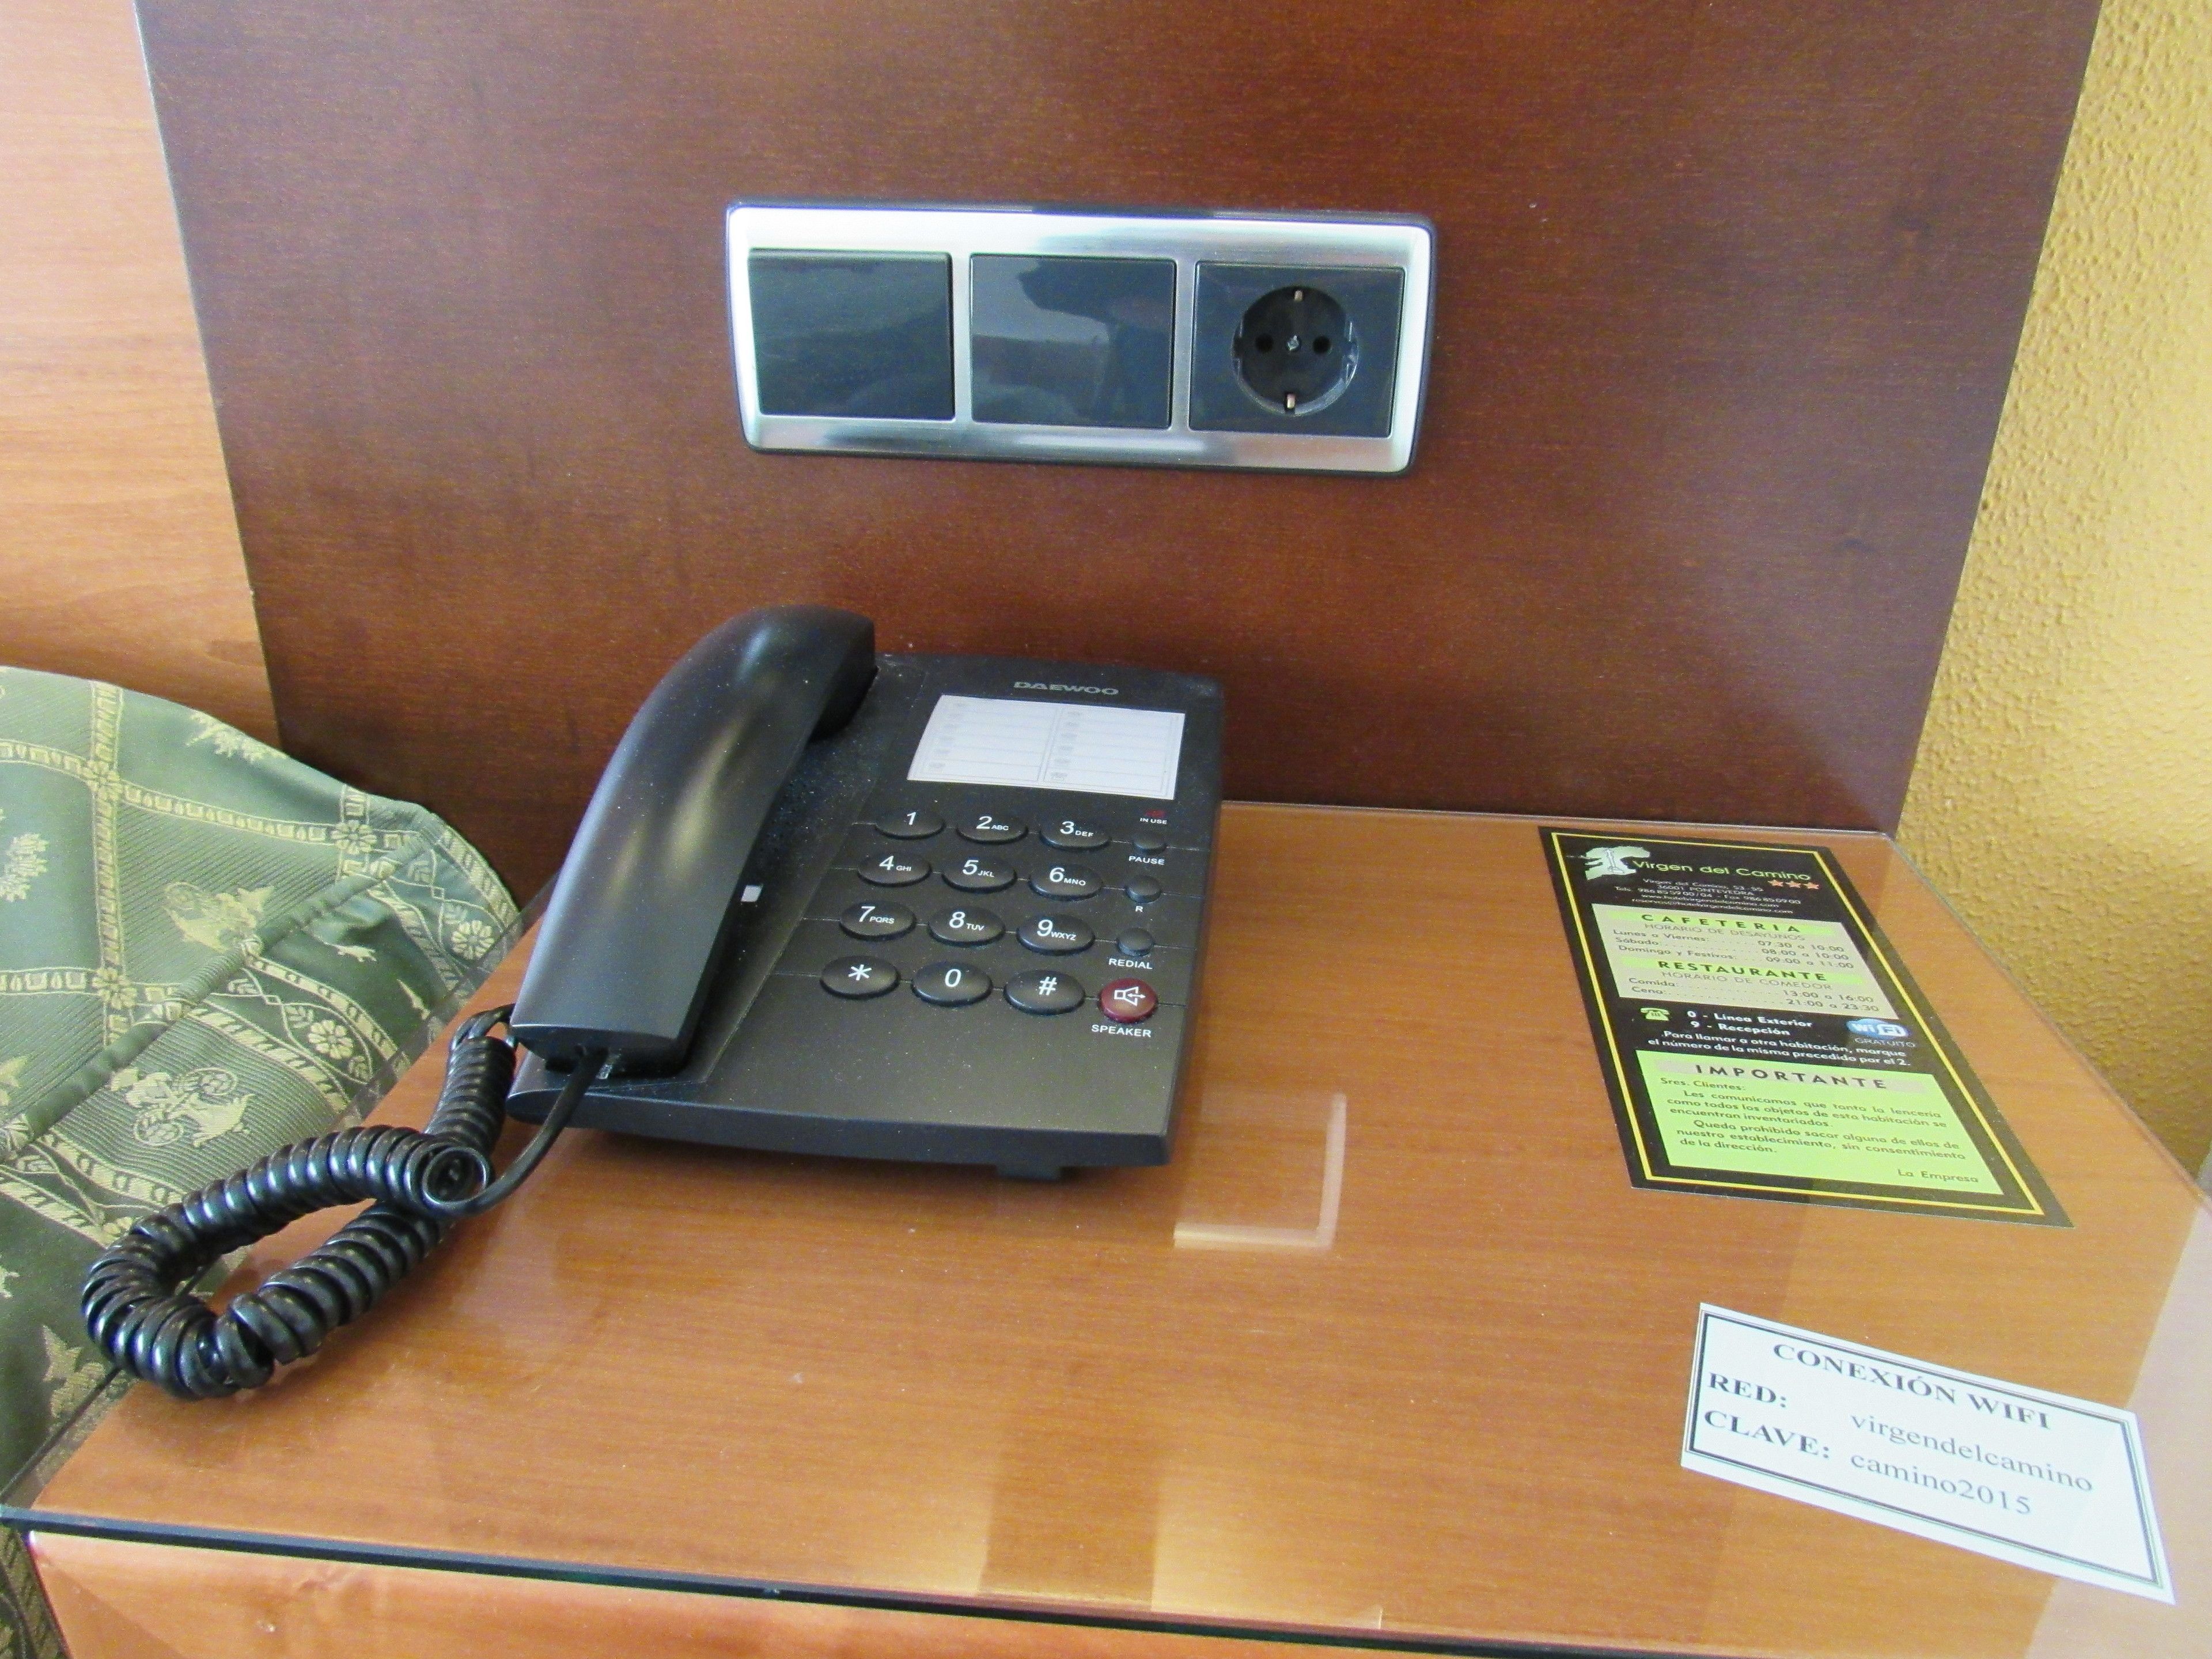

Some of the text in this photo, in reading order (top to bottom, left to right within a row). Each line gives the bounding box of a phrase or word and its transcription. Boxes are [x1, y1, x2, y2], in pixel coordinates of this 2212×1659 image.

[1013, 681, 1119, 695] DAEWOO
[907, 812, 916, 825] 1
[879, 855, 894, 870] 4
[1128, 855, 1165, 865] PAUSE
[1633, 859, 1811, 880] Virgen del Camino
[949, 911, 984, 931] 8 TUV
[1641, 914, 1800, 933] CAFETERIA
[1645, 923, 1702, 933] HORARIO
[1730, 930, 1805, 941] DESAYUNOS
[1664, 933, 1709, 941] Viernes:
[1618, 945, 1671, 955] Domingo
[1687, 950, 1737, 960] Festivos:
[1108, 958, 1153, 969] REDIAL
[1657, 960, 1827, 981] RESTAURANTE
[945, 968, 961, 987] 0
[1628, 978, 1679, 987] Comida:
[1662, 971, 1728, 982] HORARIO
[1759, 979, 1832, 990] COMEDOR
[1631, 986, 1666, 994] Cena:
[1091, 1024, 1152, 1037] SPEAKER
[1718, 1023, 1790, 1035] Recepción
[1757, 1016, 1813, 1027] Exterior
[1662, 1040, 1711, 1050] número
[1747, 1047, 1791, 1056] misma
[1792, 1051, 1857, 1062] precedido
[1663, 1031, 1692, 1039] Para
[1695, 1033, 1737, 1043] llamar
[1751, 1039, 1777, 1047] otra
[1779, 1040, 1853, 1054] habitación,
[1856, 1048, 1907, 1057] marque
[1854, 1037, 1916, 1048] GRATUITO
[1660, 1077, 1745, 1090] Sres. Clientes:
[1695, 1065, 1887, 1089] IMPORTANTE
[1683, 1090, 1704, 1098] Les
[1711, 1094, 1797, 1105] comunicamos
[1804, 1101, 1827, 1110] que
[1832, 1103, 1866, 1112] tanto
[1667, 1099, 1700, 1107] como
[1705, 1101, 1738, 1110] todos
[1764, 1107, 1809, 1116] objetos
[1832, 1112, 1858, 1120] esta
[1862, 1114, 1929, 1126] habitación
[1670, 1108, 1834, 1127] encuentran inventariados.
[1694, 1120, 1736, 1130] Queda
[1741, 1126, 1801, 1136] prohibido
[1805, 1130, 1839, 1139] sacar
[1843, 1133, 1887, 1143] alguno
[1910, 1139, 1940, 1148] ellos
[1944, 1141, 1960, 1149] de
[1676, 1129, 1966, 1160] nuestro establecimiento, sin consentimiento
[1680, 1138, 1777, 1153] de la dirección.
[1898, 1169, 1979, 1183] La Empresa
[1773, 1342, 2054, 1430] CONEXIÓN WIFI
[1707, 1372, 2094, 1492] RED: virgendelcamino
[1703, 1409, 2032, 1516] CLAVE: camino2015
